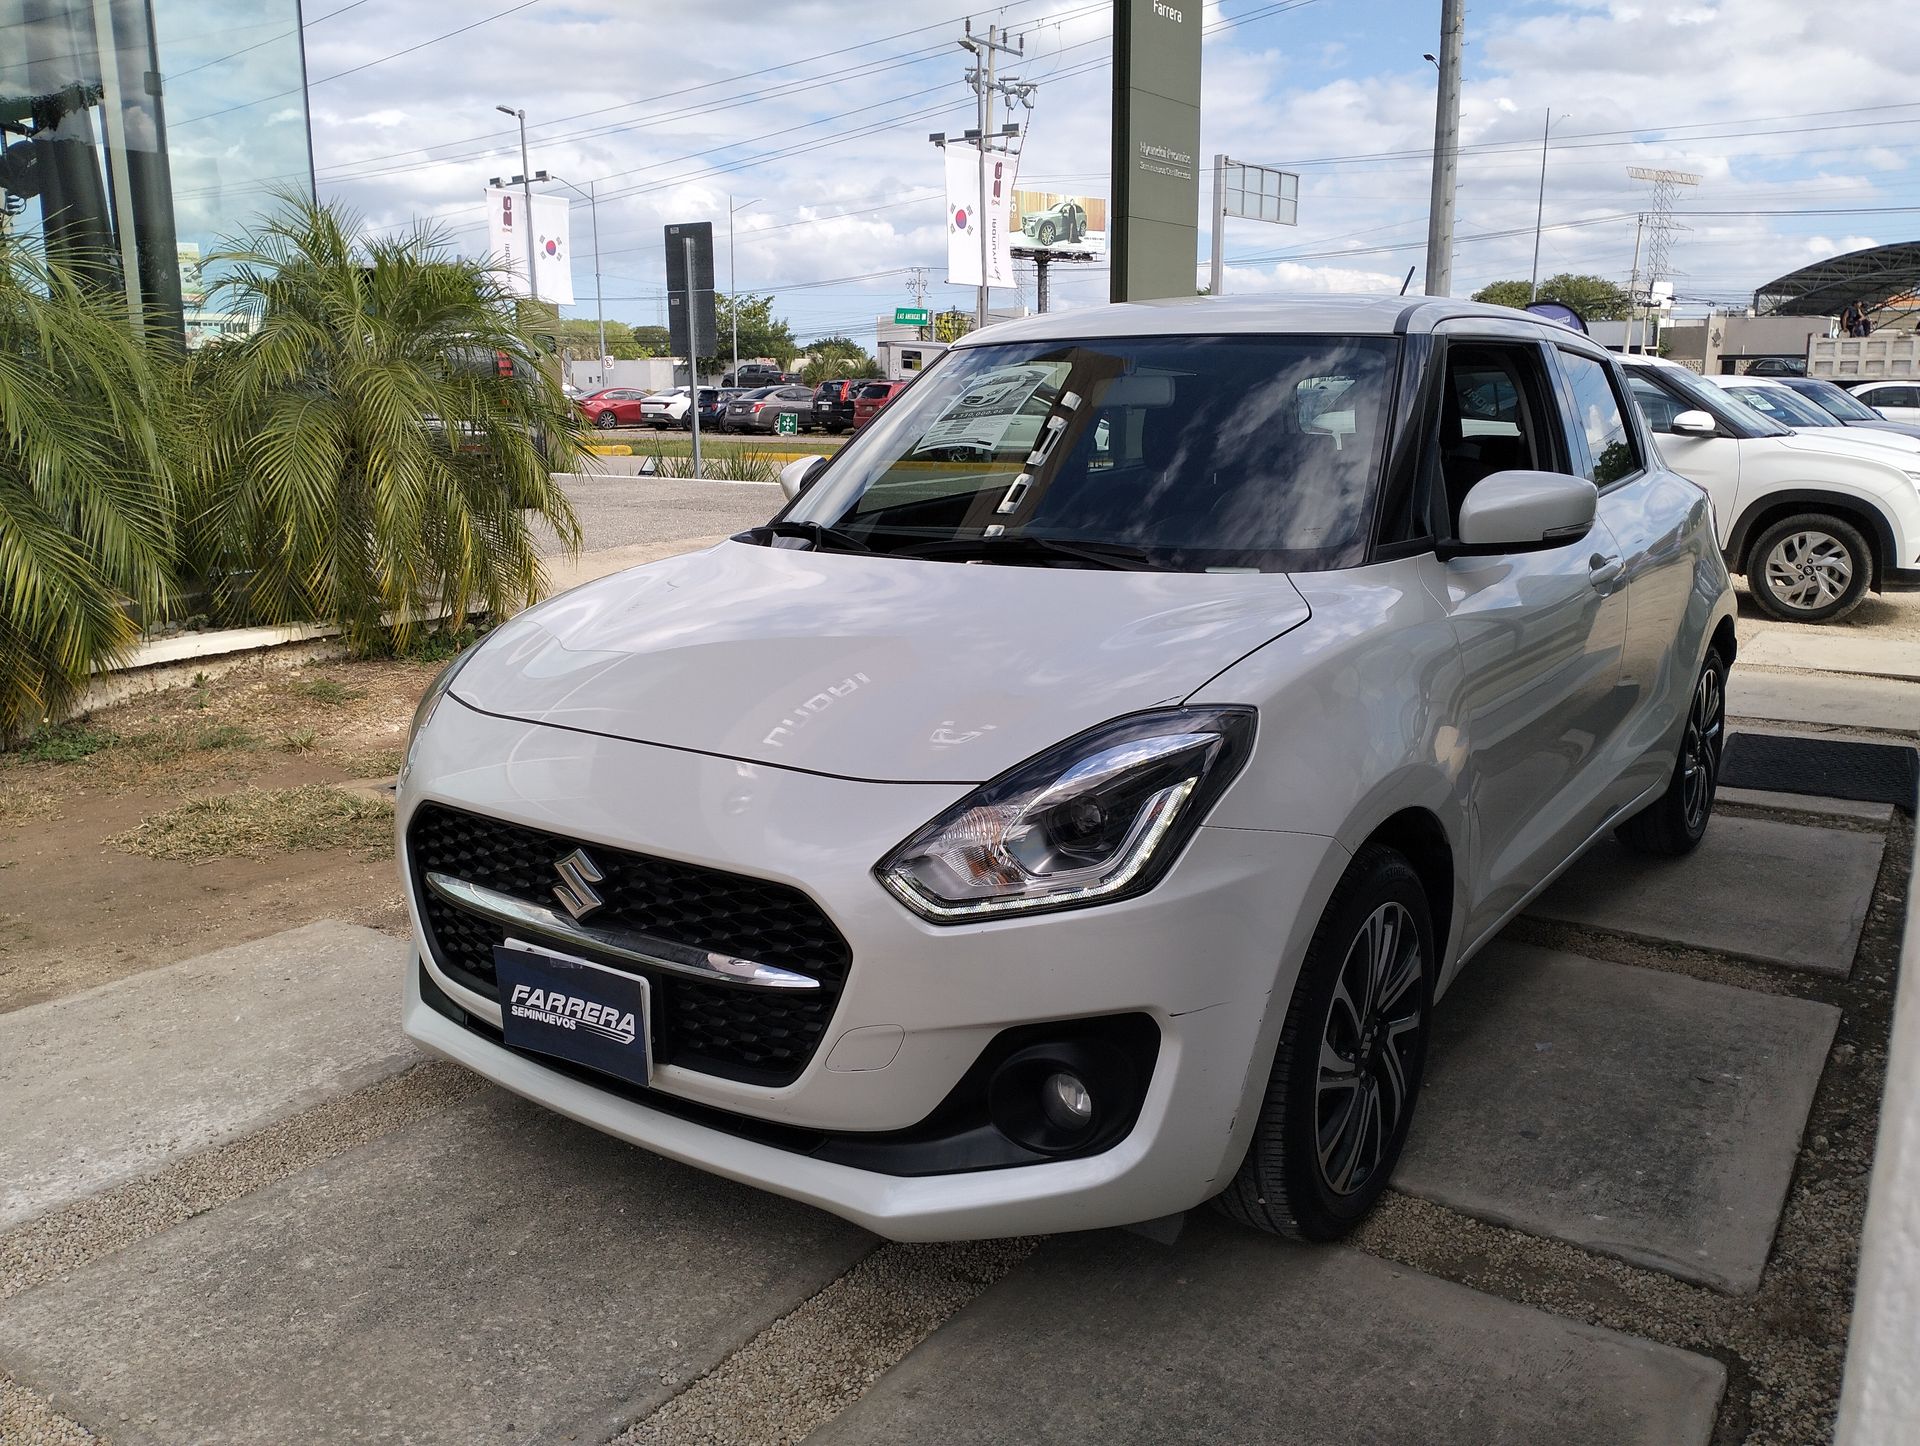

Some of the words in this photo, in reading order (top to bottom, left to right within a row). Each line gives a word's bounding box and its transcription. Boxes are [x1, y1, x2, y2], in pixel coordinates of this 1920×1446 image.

[1153, 0, 1182, 23] Farrera
[993, 160, 1003, 198] 26
[503, 195, 512, 226] 26
[510, 983, 636, 1035] FARRERA
[511, 1005, 577, 1031] SEMINUEVOS
